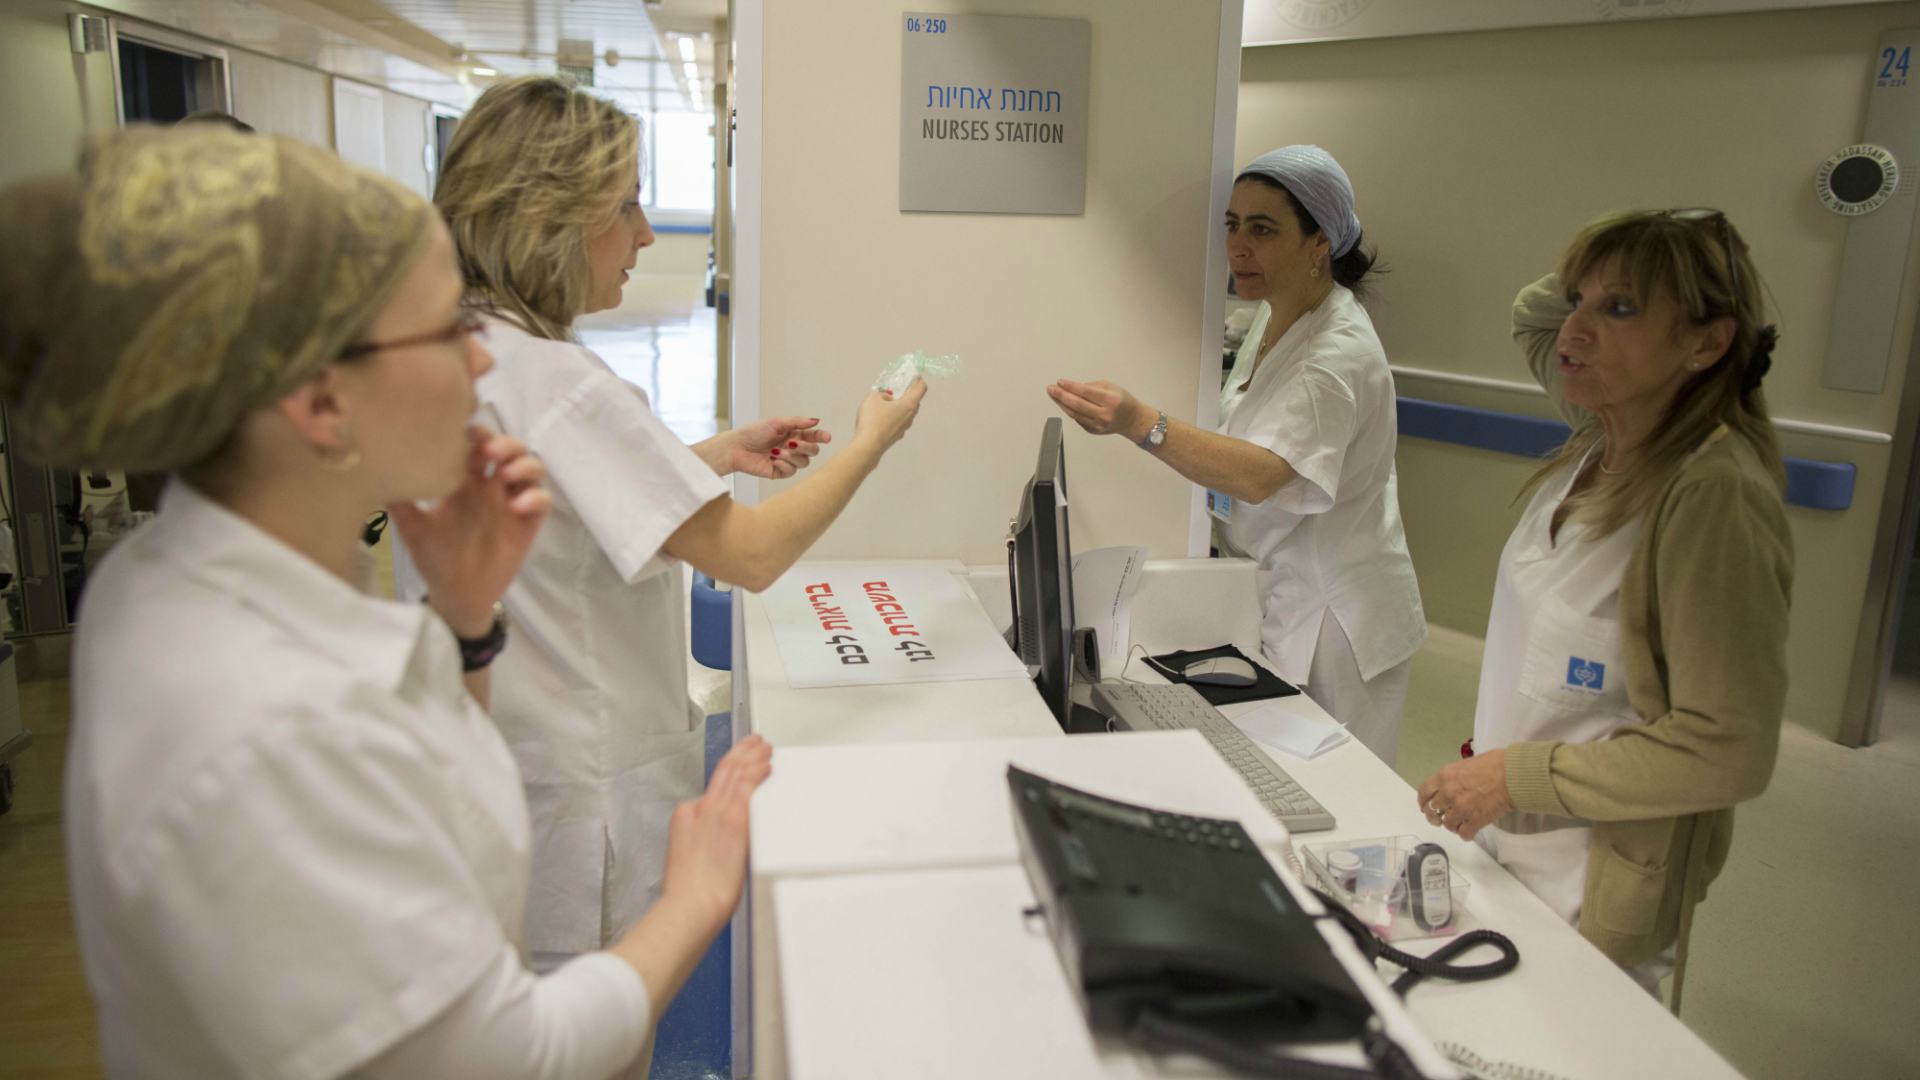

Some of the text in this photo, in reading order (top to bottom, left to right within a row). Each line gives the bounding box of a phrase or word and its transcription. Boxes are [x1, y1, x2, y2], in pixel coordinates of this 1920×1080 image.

[1879, 46, 1912, 78] 24
[926, 85, 1061, 113] תחנת אחיות
[922, 118, 1064, 144] NURSES STATION
[1836, 146, 1886, 159] HADASSAH
[1818, 160, 1835, 202] RESEARCH
[1879, 160, 1896, 199] HEALING
[805, 582, 870, 665] בריאות לכם
[862, 580, 936, 662] משכורת לנו
